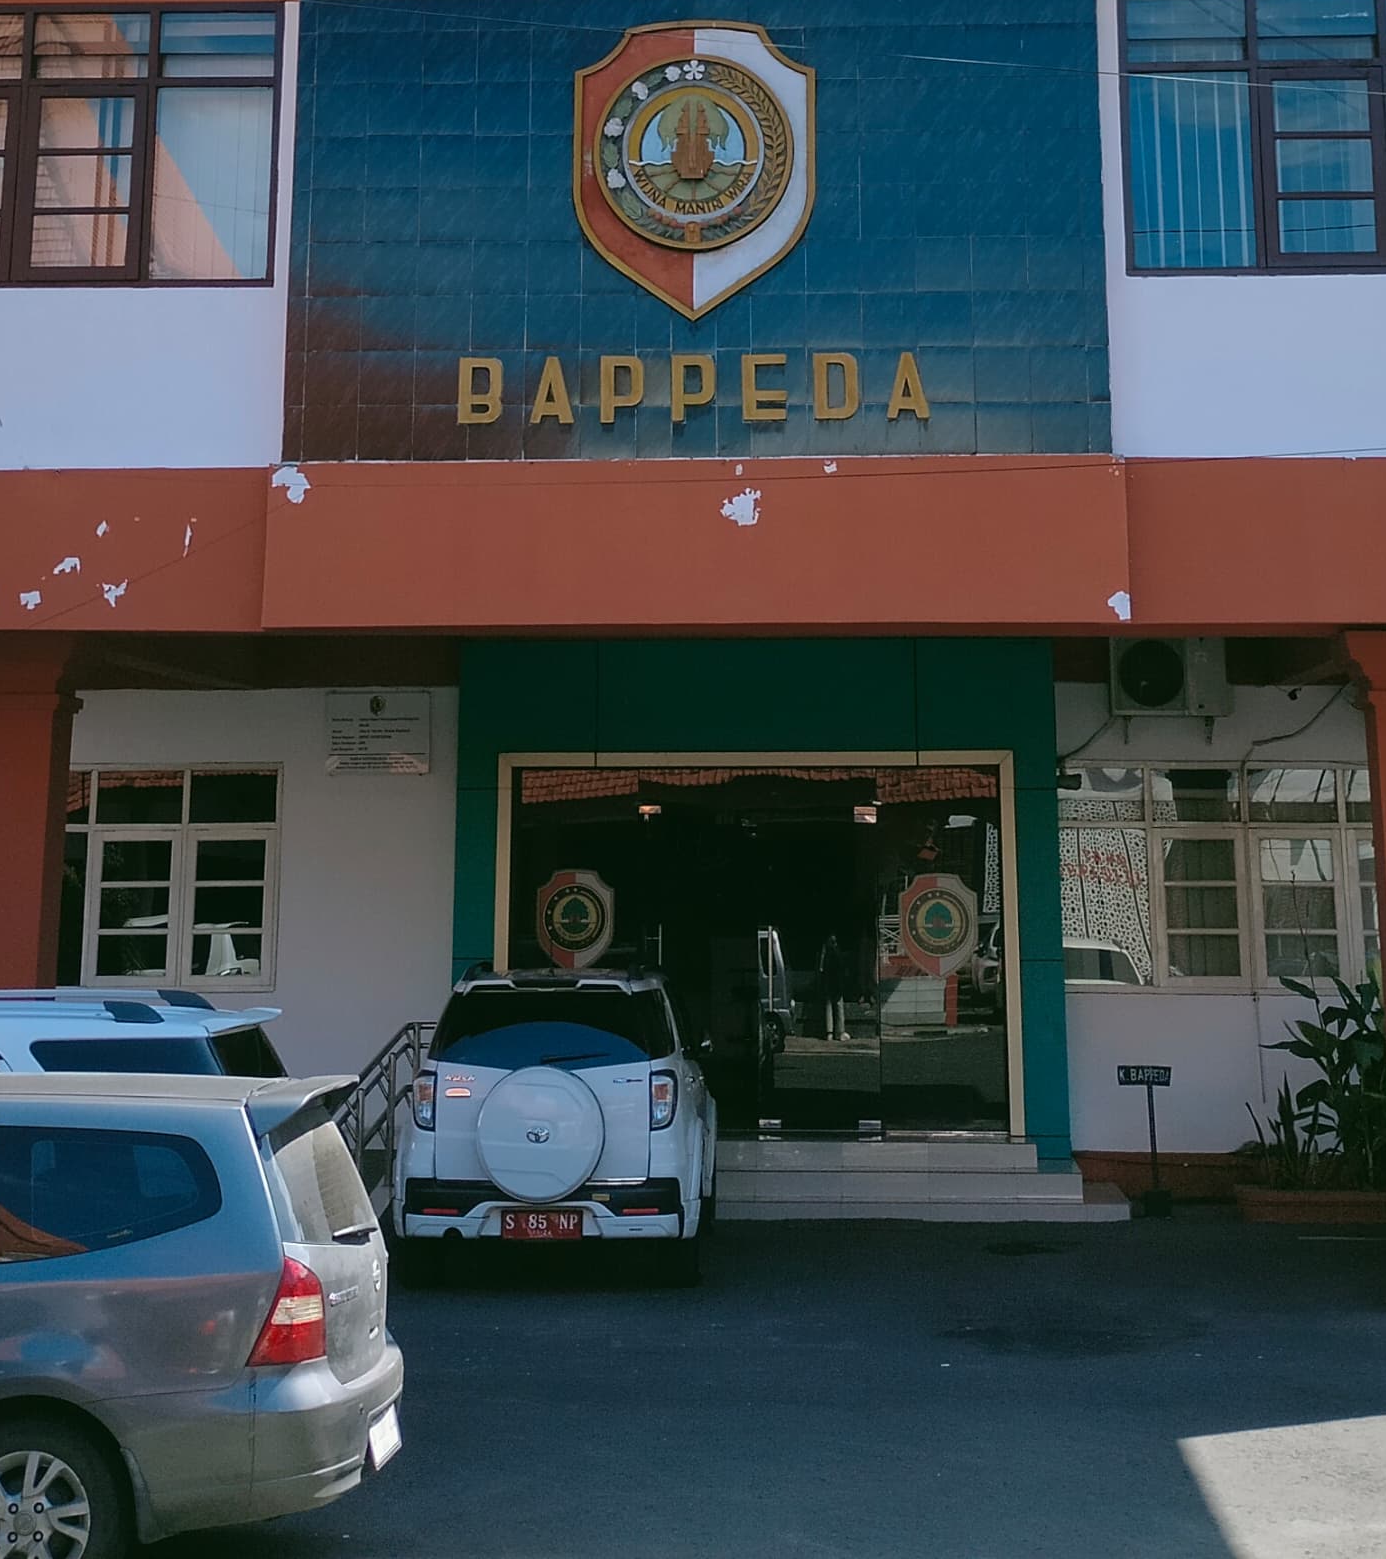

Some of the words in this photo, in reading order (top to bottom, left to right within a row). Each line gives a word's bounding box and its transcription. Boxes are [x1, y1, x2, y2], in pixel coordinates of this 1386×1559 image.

[674, 200, 724, 215] MANTRI
[726, 171, 754, 201] WIRA
[456, 351, 931, 425] BAPPEDA
[505, 1214, 515, 1230] S
[528, 1214, 548, 1229] 85
[559, 1214, 578, 1230] NP
